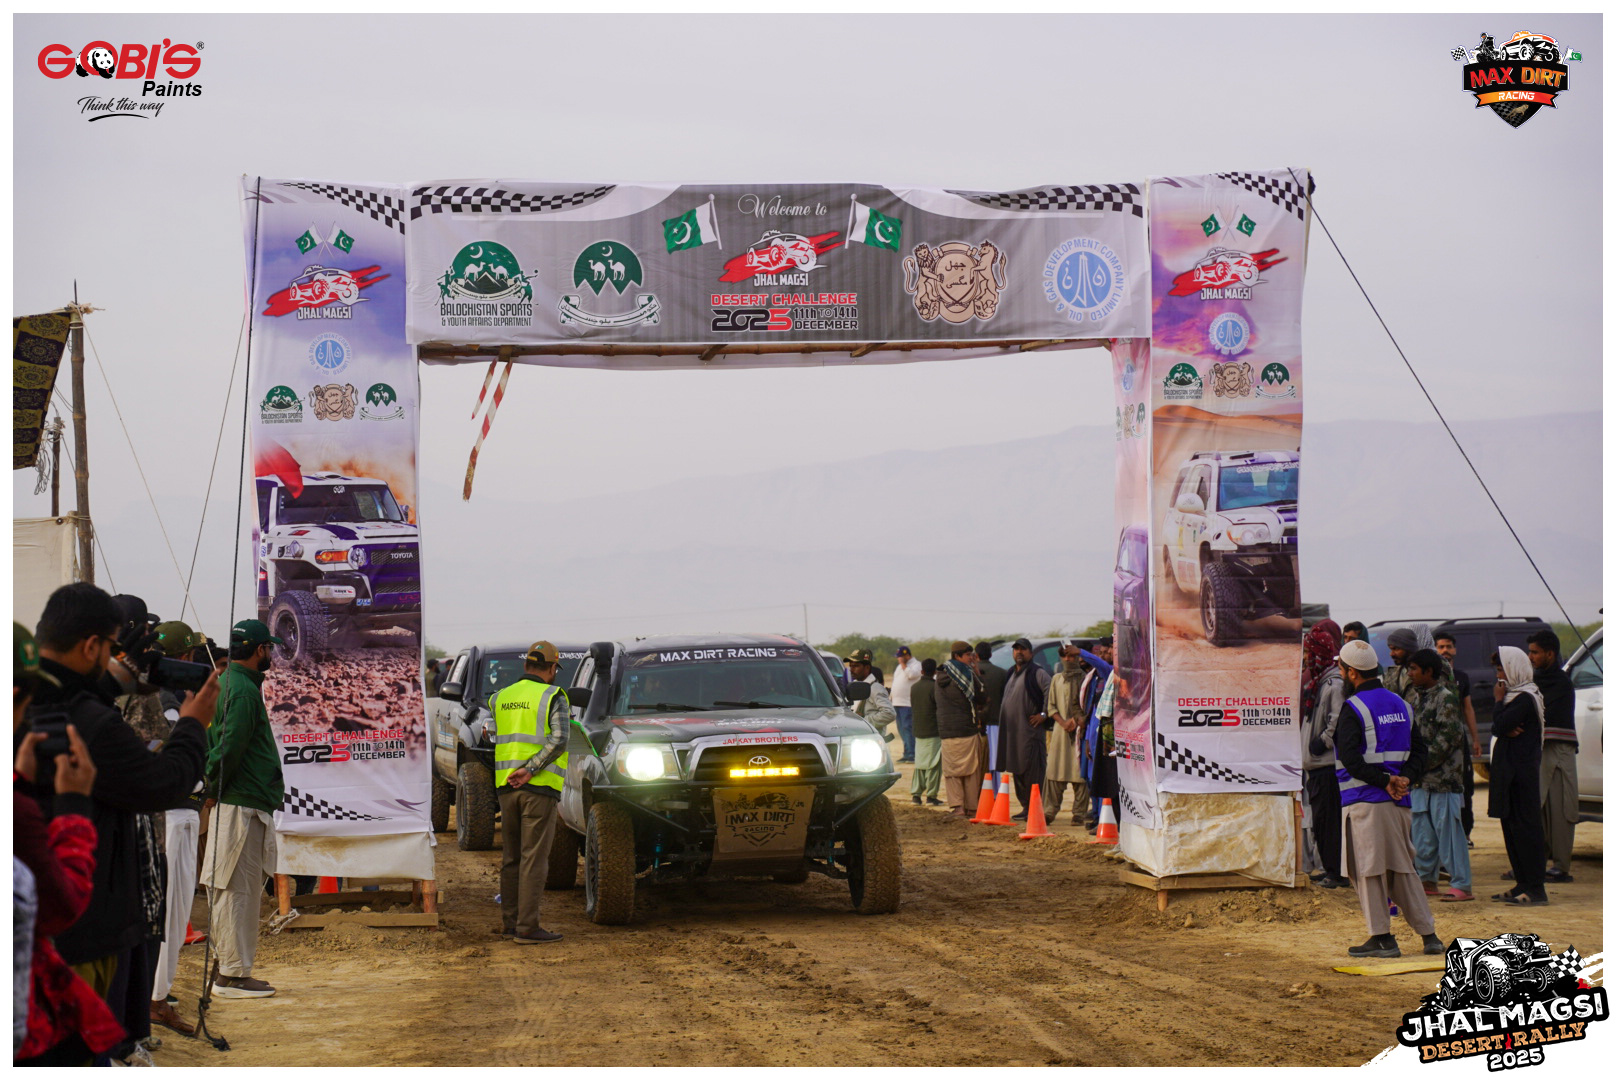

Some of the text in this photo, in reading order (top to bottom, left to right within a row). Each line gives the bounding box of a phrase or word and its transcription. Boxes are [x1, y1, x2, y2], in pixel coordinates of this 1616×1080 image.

[738, 194, 827, 218] Welcome to
[754, 273, 808, 286] JHAL MAGSI
[1044, 238, 1124, 321] OIL & GAS DEVELOPMENT COMPANY LIMITED
[711, 293, 857, 306] DESERT CHALLENGE
[1201, 288, 1251, 300] JHAL MAGSI
[298, 306, 351, 320] JHAL MAGSI
[440, 303, 532, 316] BALOCHISTAN SPORTS
[793, 307, 857, 319] 11th TO 14th
[447, 317, 466, 326] YOUTH
[468, 317, 492, 326] AFFAIRS
[494, 317, 532, 326] DEPARTMENT
[711, 308, 792, 332] 2025
[794, 320, 858, 330] DECEMBER
[660, 648, 777, 662] MAX DIRT RACING
[501, 702, 530, 711] MARSHALL
[1178, 697, 1291, 707] DESERT CHALLENGE
[1178, 709, 1241, 727] 2025
[1242, 708, 1259, 717] 11th
[1272, 708, 1291, 717] 14th
[283, 729, 405, 744] DESERT CHALLENGE
[352, 742, 371, 751] 11th
[385, 740, 405, 749] 14th
[283, 744, 351, 765] 2025
[352, 751, 405, 760] DECEMBER
[730, 812, 792, 825] MAX DIRT
